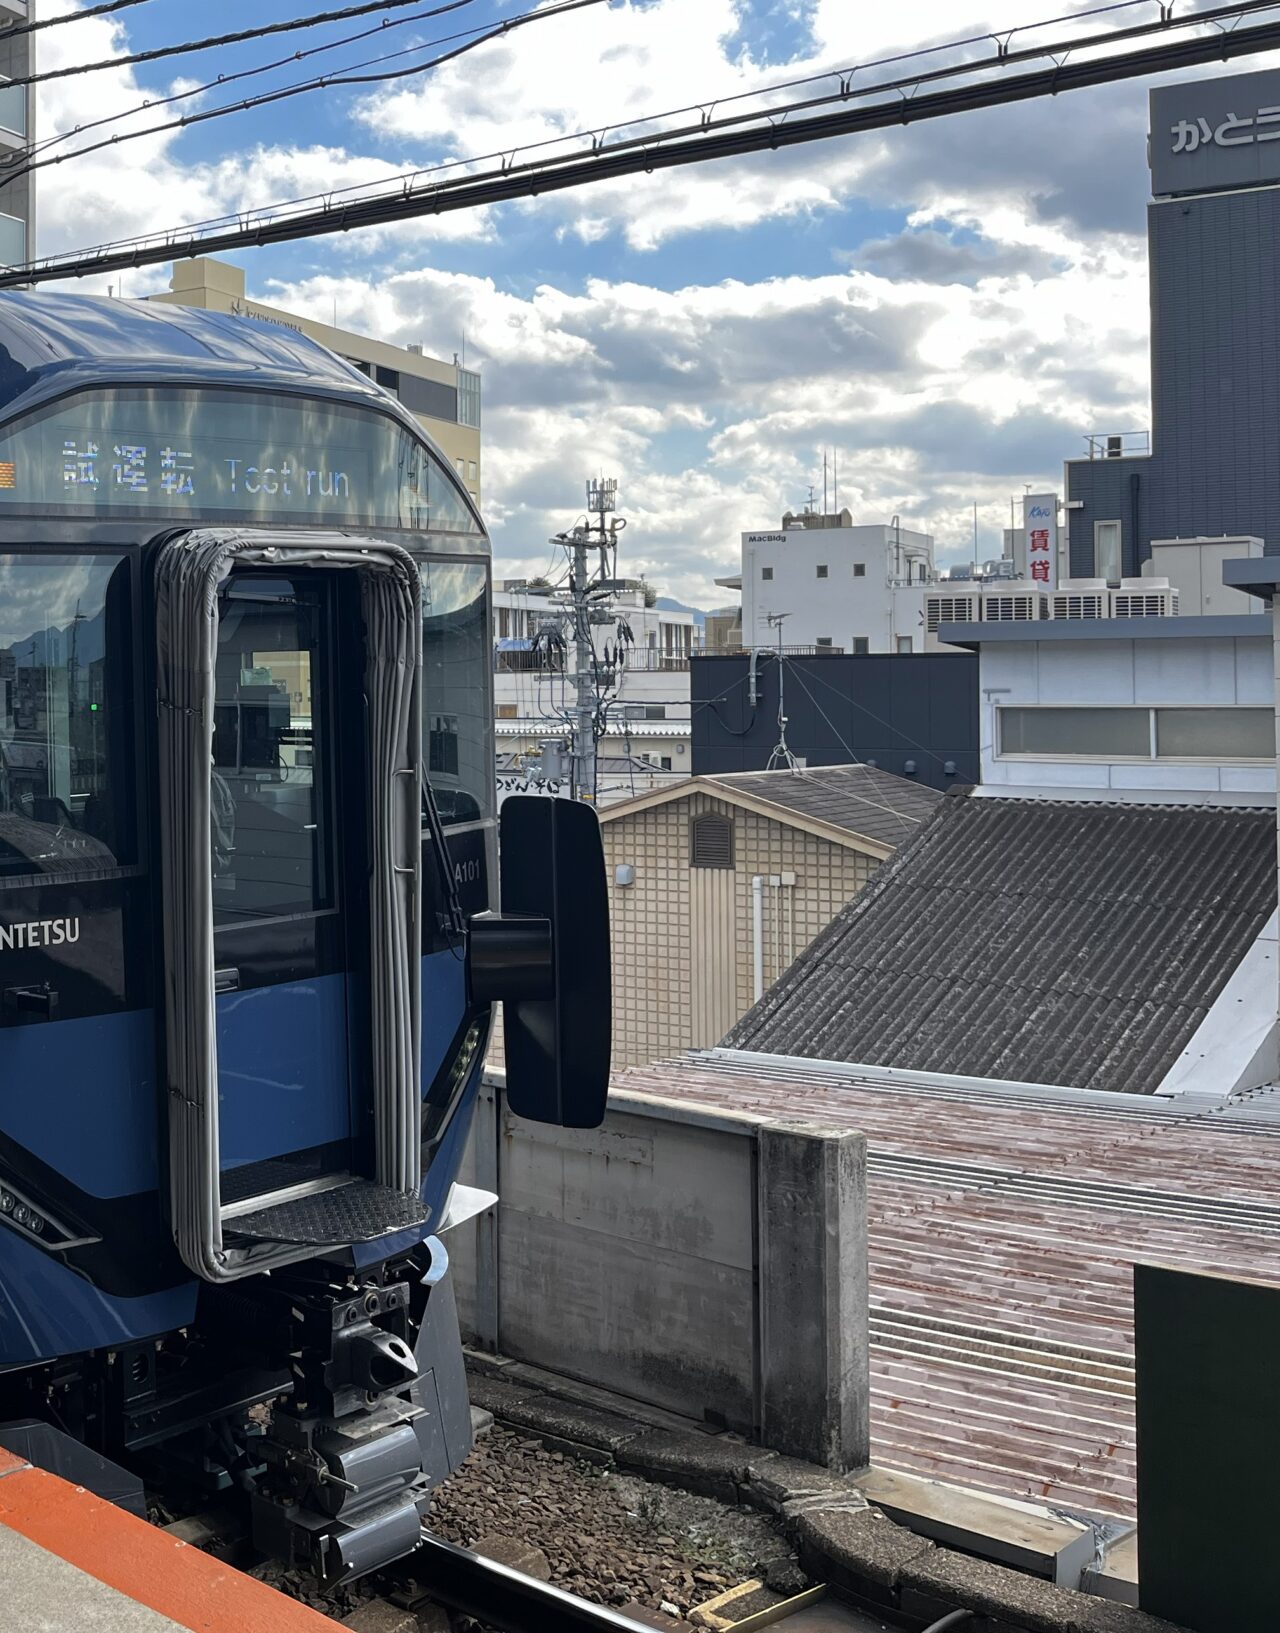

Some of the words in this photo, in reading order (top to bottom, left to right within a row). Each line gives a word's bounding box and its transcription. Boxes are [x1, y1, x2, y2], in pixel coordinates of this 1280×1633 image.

[62, 441, 195, 496] 試運転
[306, 469, 349, 497] run
[1030, 529, 1050, 583] 賃貸
